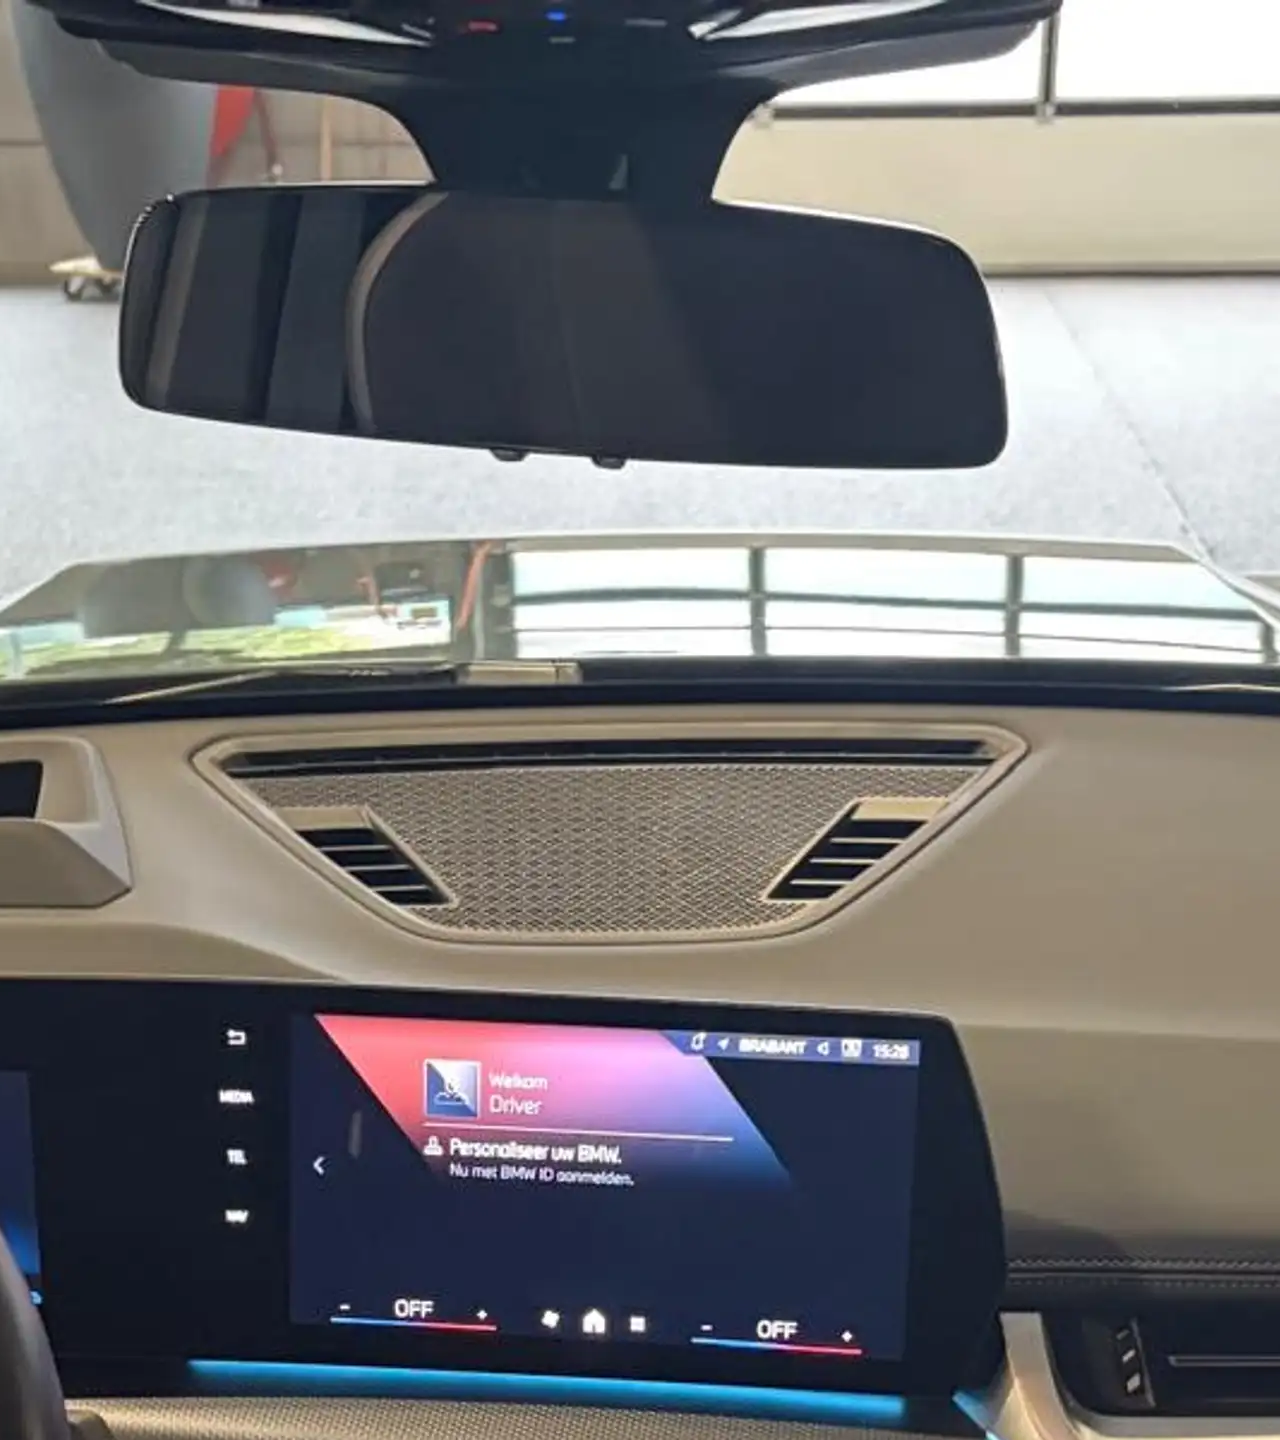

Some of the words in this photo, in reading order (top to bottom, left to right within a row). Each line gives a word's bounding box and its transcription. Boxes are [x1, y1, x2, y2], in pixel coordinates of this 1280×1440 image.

[738, 1037, 807, 1055] BRABANT
[488, 1072, 548, 1091] Welkom
[489, 1094, 543, 1115] Driver
[449, 1137, 550, 1161] Personaliseer
[551, 1147, 575, 1162] uw
[577, 1144, 622, 1164] BMW.
[449, 1163, 468, 1178] Nu
[471, 1166, 498, 1181] met
[500, 1164, 535, 1182] BMW
[538, 1167, 555, 1182] ID
[556, 1169, 635, 1187] aanmelden.
[394, 1299, 434, 1319] OFF
[756, 1321, 797, 1341] OFF
